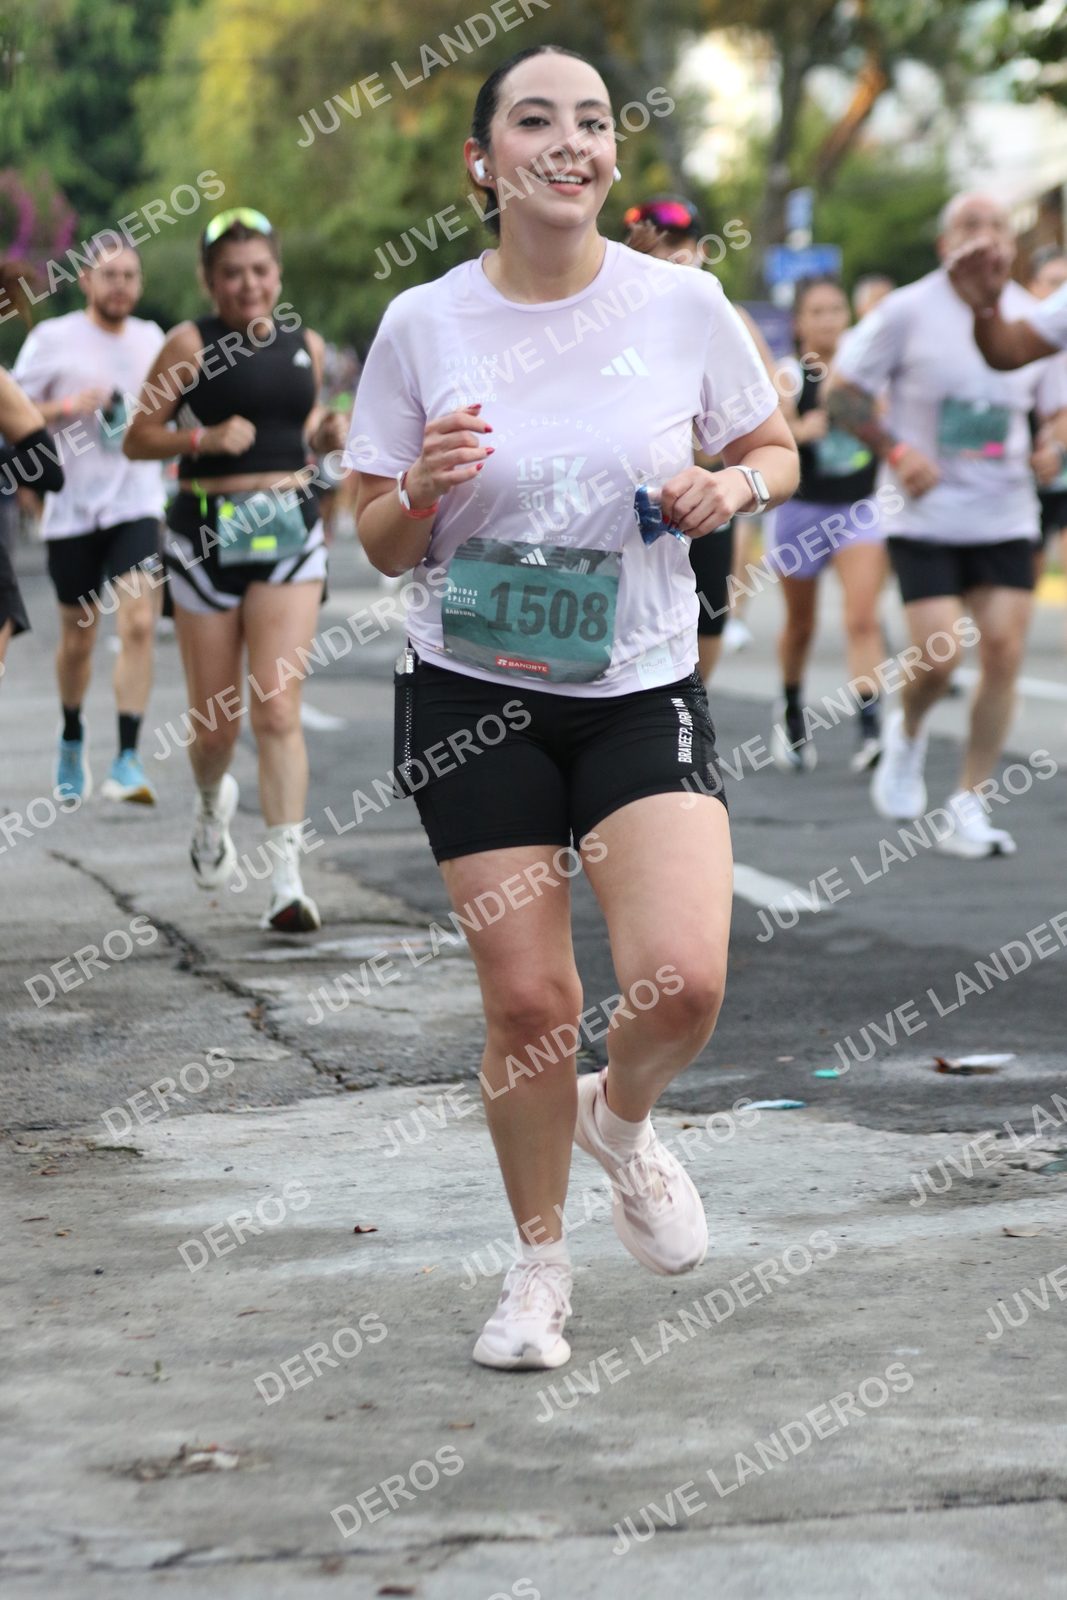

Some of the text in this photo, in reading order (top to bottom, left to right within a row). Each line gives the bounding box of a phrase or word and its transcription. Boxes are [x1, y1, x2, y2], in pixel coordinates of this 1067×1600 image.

[516, 457, 544, 481] 15
[553, 457, 589, 514] K
[518, 490, 546, 511] 30
[447, 586, 478, 597] ADIDAS
[447, 594, 477, 605] SPLITS
[487, 582, 609, 642] 1508
[508, 660, 548, 673] BANORTE
